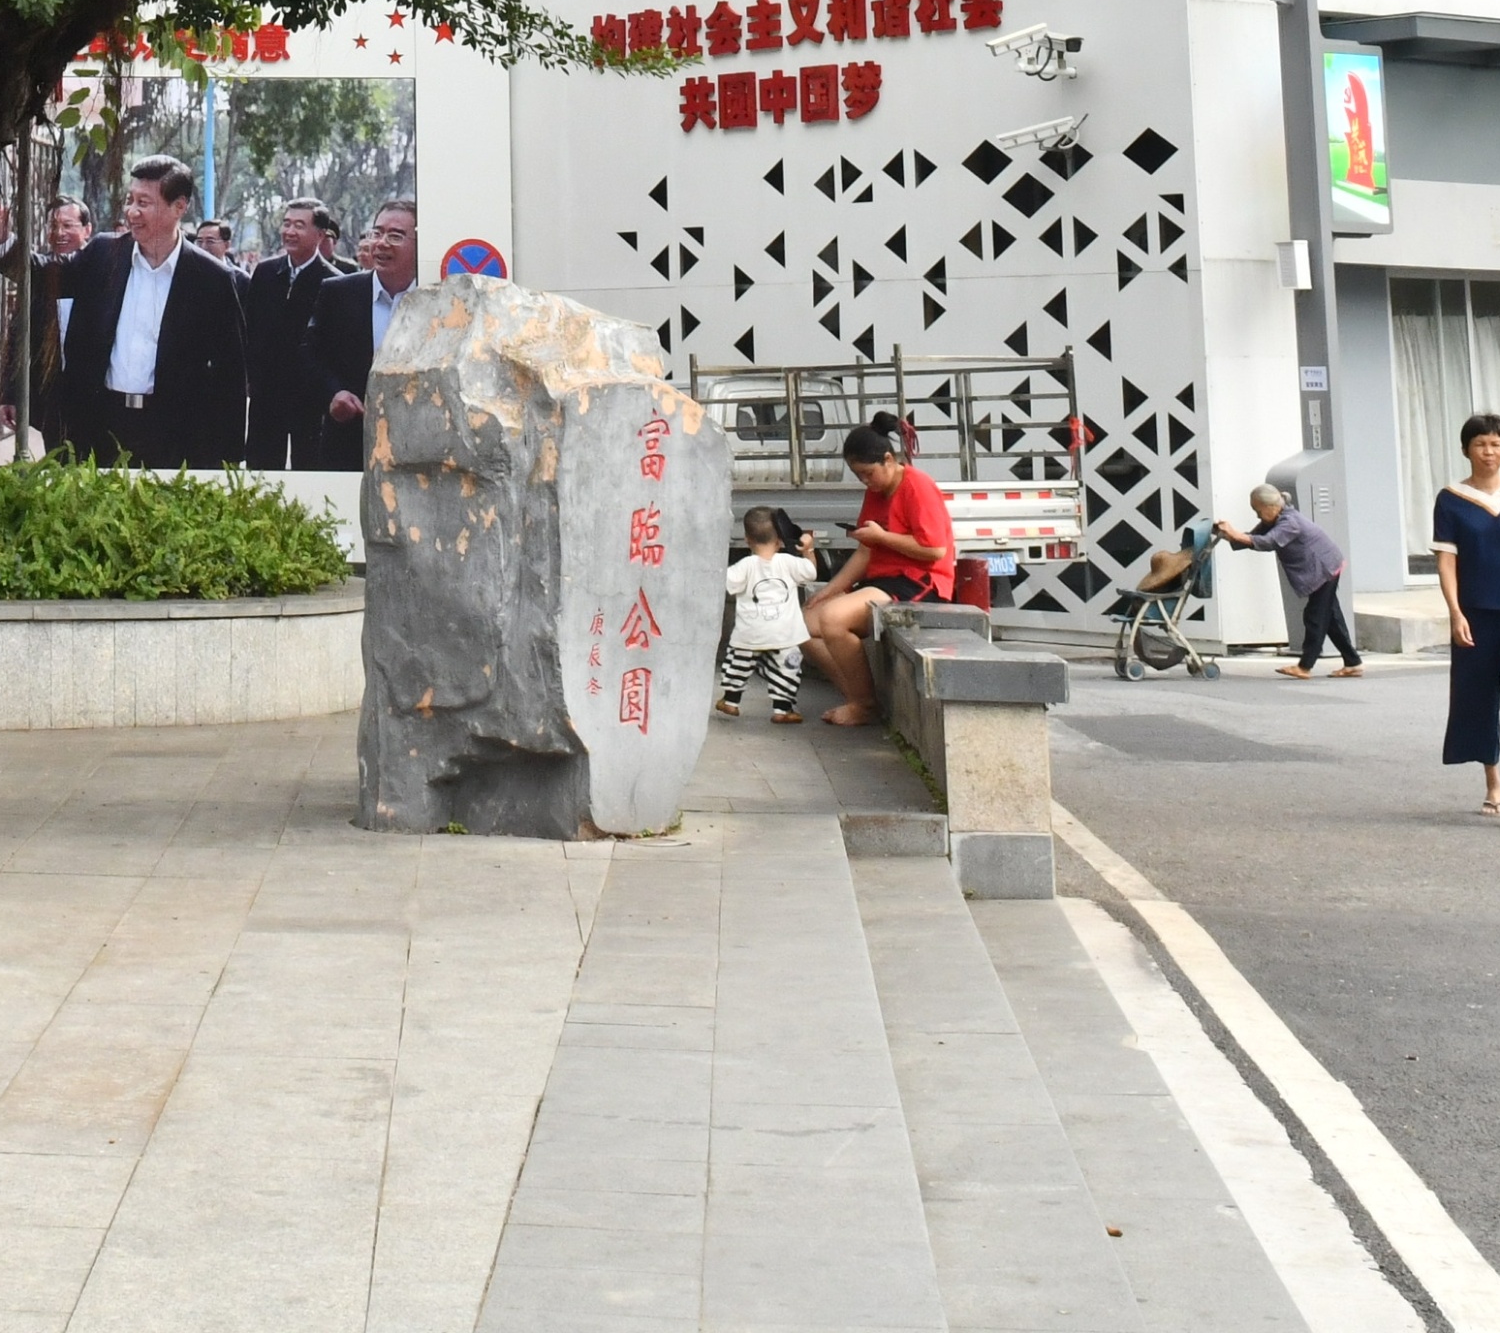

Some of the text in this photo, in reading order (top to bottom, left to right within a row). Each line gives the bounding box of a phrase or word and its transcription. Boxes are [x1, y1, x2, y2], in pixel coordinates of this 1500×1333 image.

[679, 60, 883, 133] 共圆中国梦
[619, 407, 671, 735] 富臨公園
